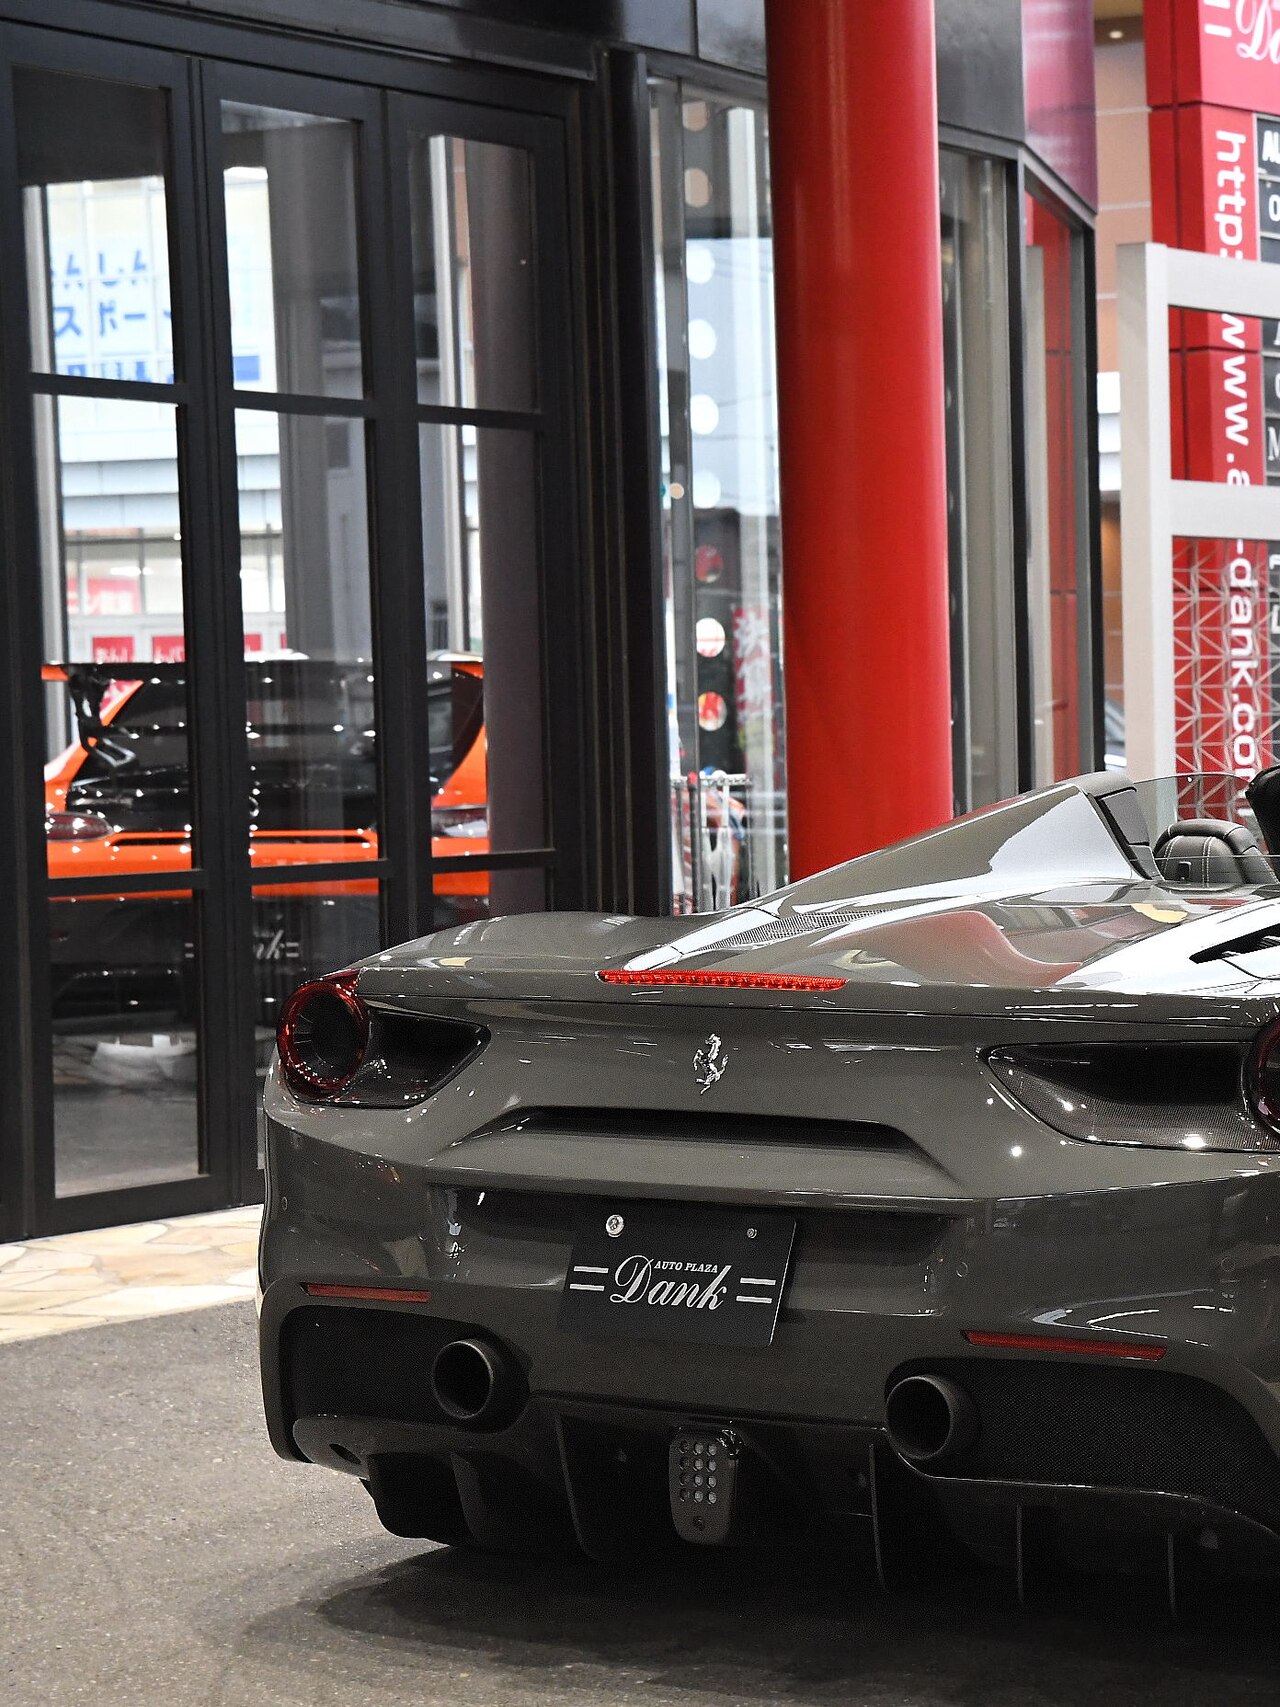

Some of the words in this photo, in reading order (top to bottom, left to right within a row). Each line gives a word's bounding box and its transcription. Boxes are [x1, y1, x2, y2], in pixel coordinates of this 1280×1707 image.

[610, 1255, 732, 1310] Dank
[654, 1260, 682, 1271] AUTO
[684, 1262, 718, 1273] PLAZA
